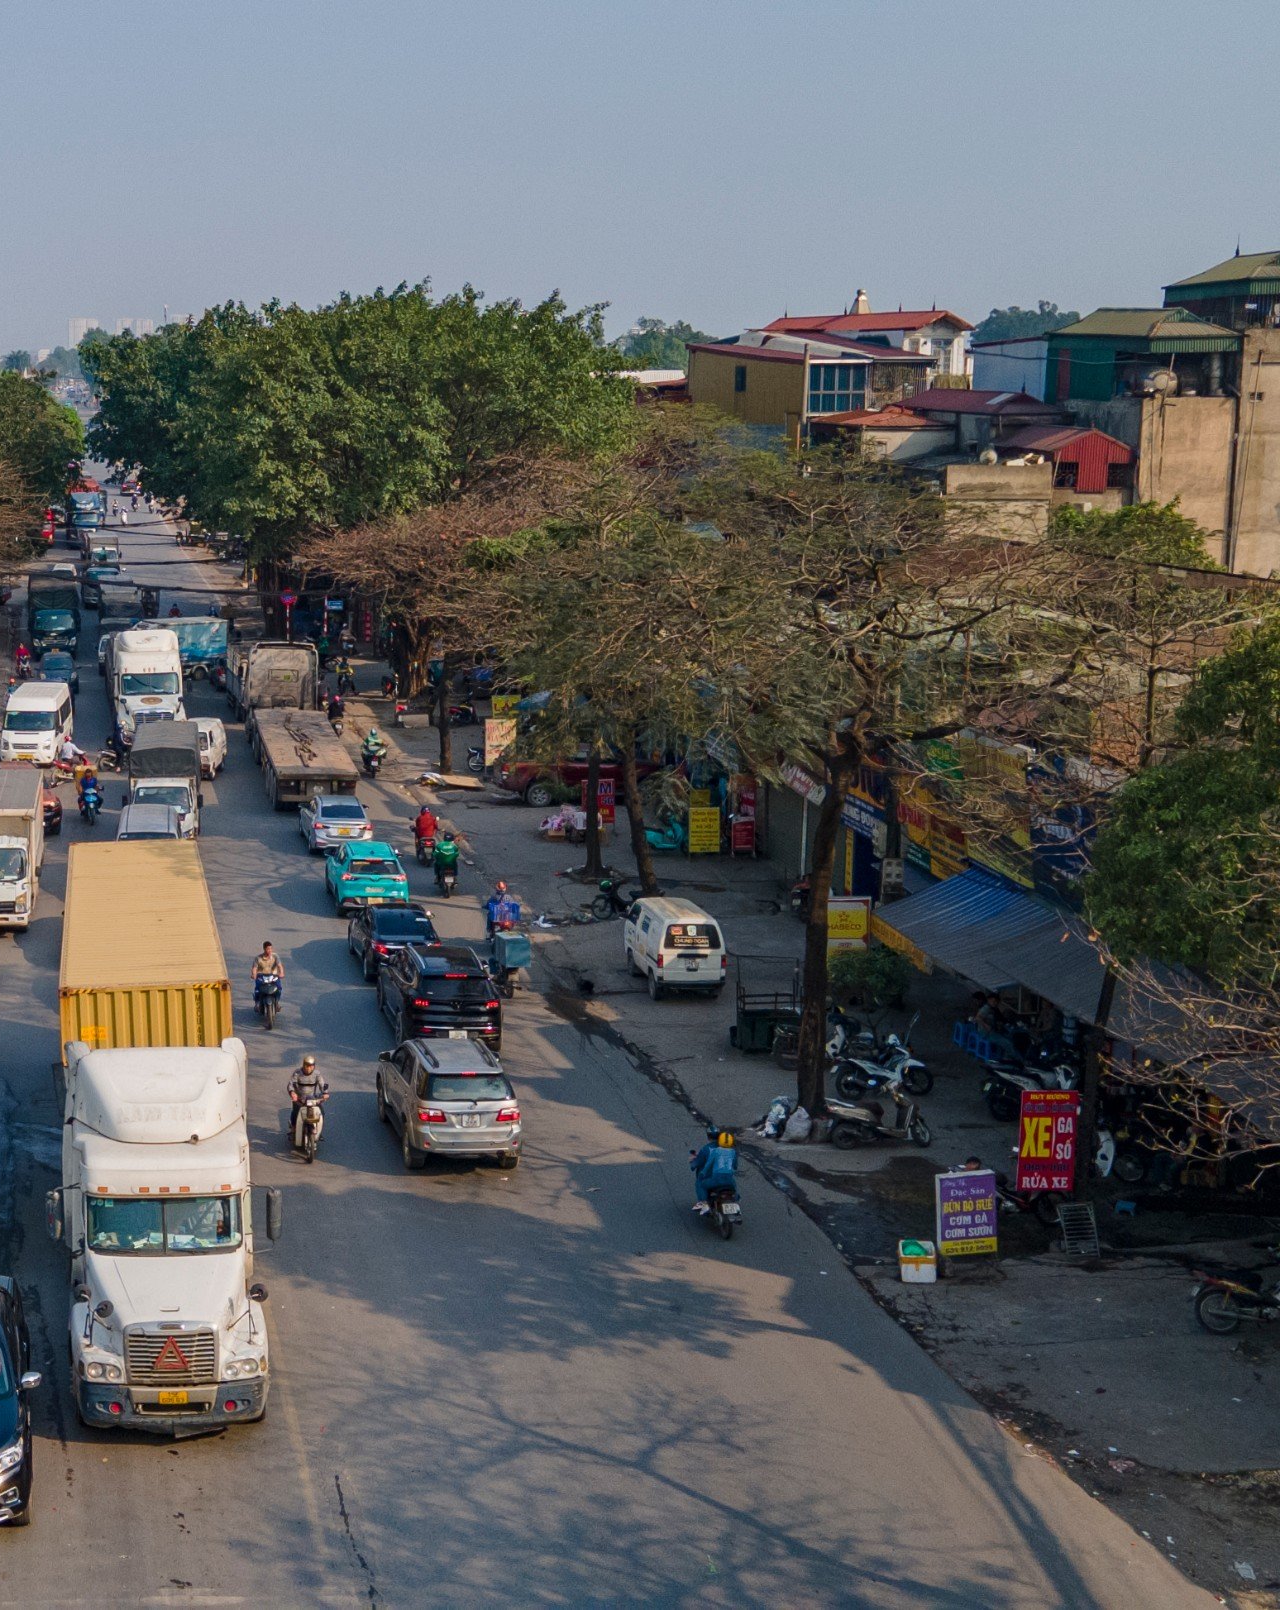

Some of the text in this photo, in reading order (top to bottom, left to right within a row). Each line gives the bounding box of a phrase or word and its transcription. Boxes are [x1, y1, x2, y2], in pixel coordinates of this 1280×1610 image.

[1057, 1116, 1073, 1134] GA
[1020, 1117, 1053, 1158] XE
[1055, 1137, 1073, 1160] SỐ
[1022, 1172, 1068, 1189] RỬA XE
[962, 1197, 974, 1213] BÒ
[976, 1193, 993, 1211] HUẾ
[975, 1211, 988, 1224] GÀ
